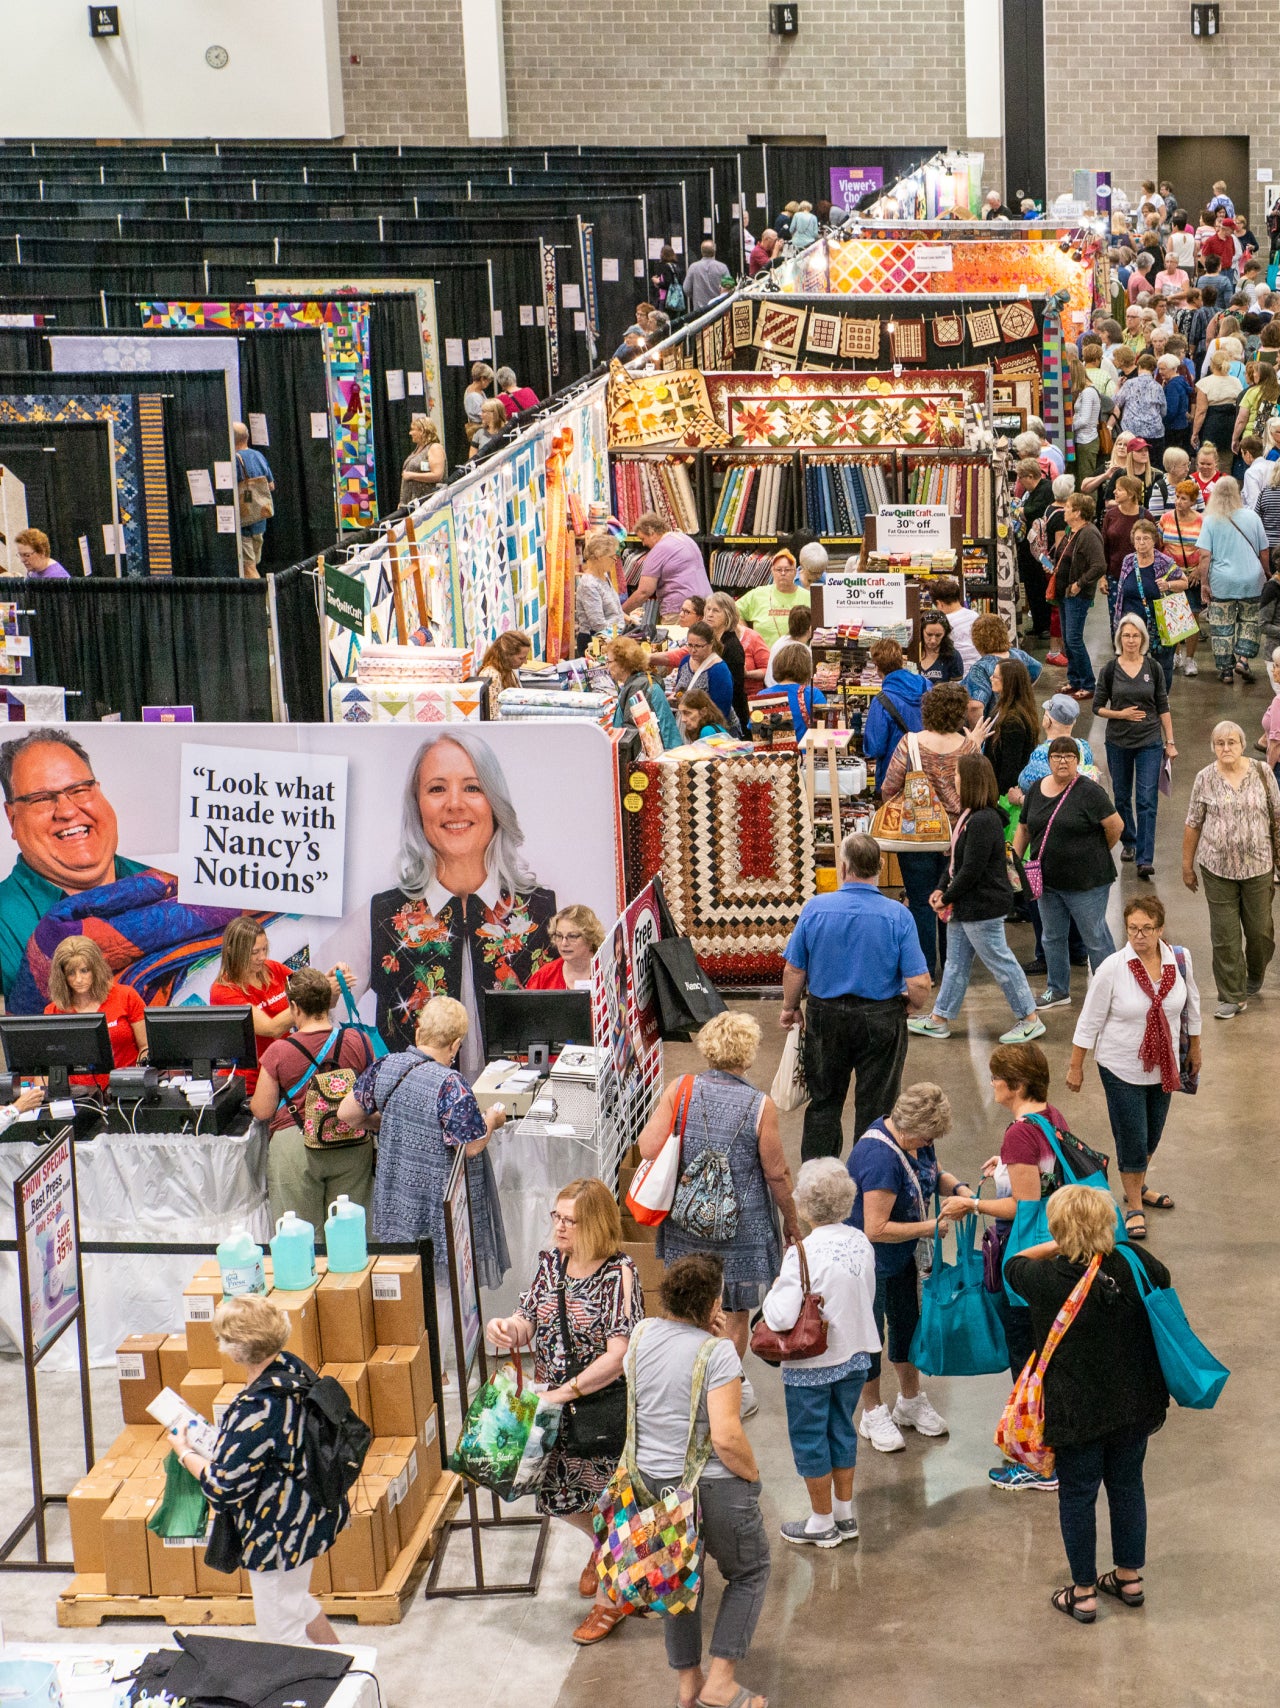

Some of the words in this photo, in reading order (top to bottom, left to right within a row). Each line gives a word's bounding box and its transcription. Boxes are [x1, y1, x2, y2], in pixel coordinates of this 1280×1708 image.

[839, 179, 876, 191] Viewer's
[844, 191, 862, 203] Cho
[880, 509, 946, 518] SewQuiltCraft.com
[916, 519, 931, 528] off
[828, 577, 901, 588] SewQuiltCraft.com
[846, 589, 866, 599] 30%
[868, 589, 884, 599] off
[193, 767, 268, 796] “Look
[275, 776, 335, 801] what
[190, 796, 200, 818] I
[207, 801, 274, 824] made
[281, 806, 336, 830] with
[203, 825, 320, 868] Nancy’s
[194, 857, 328, 893] Notions”
[635, 919, 652, 955] Free
[636, 947, 653, 982] Tote
[21, 1174, 41, 1202] SHOW
[42, 1143, 69, 1183] SPECIAL
[31, 1191, 45, 1215] Best
[45, 1174, 63, 1198] Press
[56, 1219, 70, 1239] SAVE
[56, 1238, 73, 1265] 35%
[228, 1279, 246, 1288] Press
